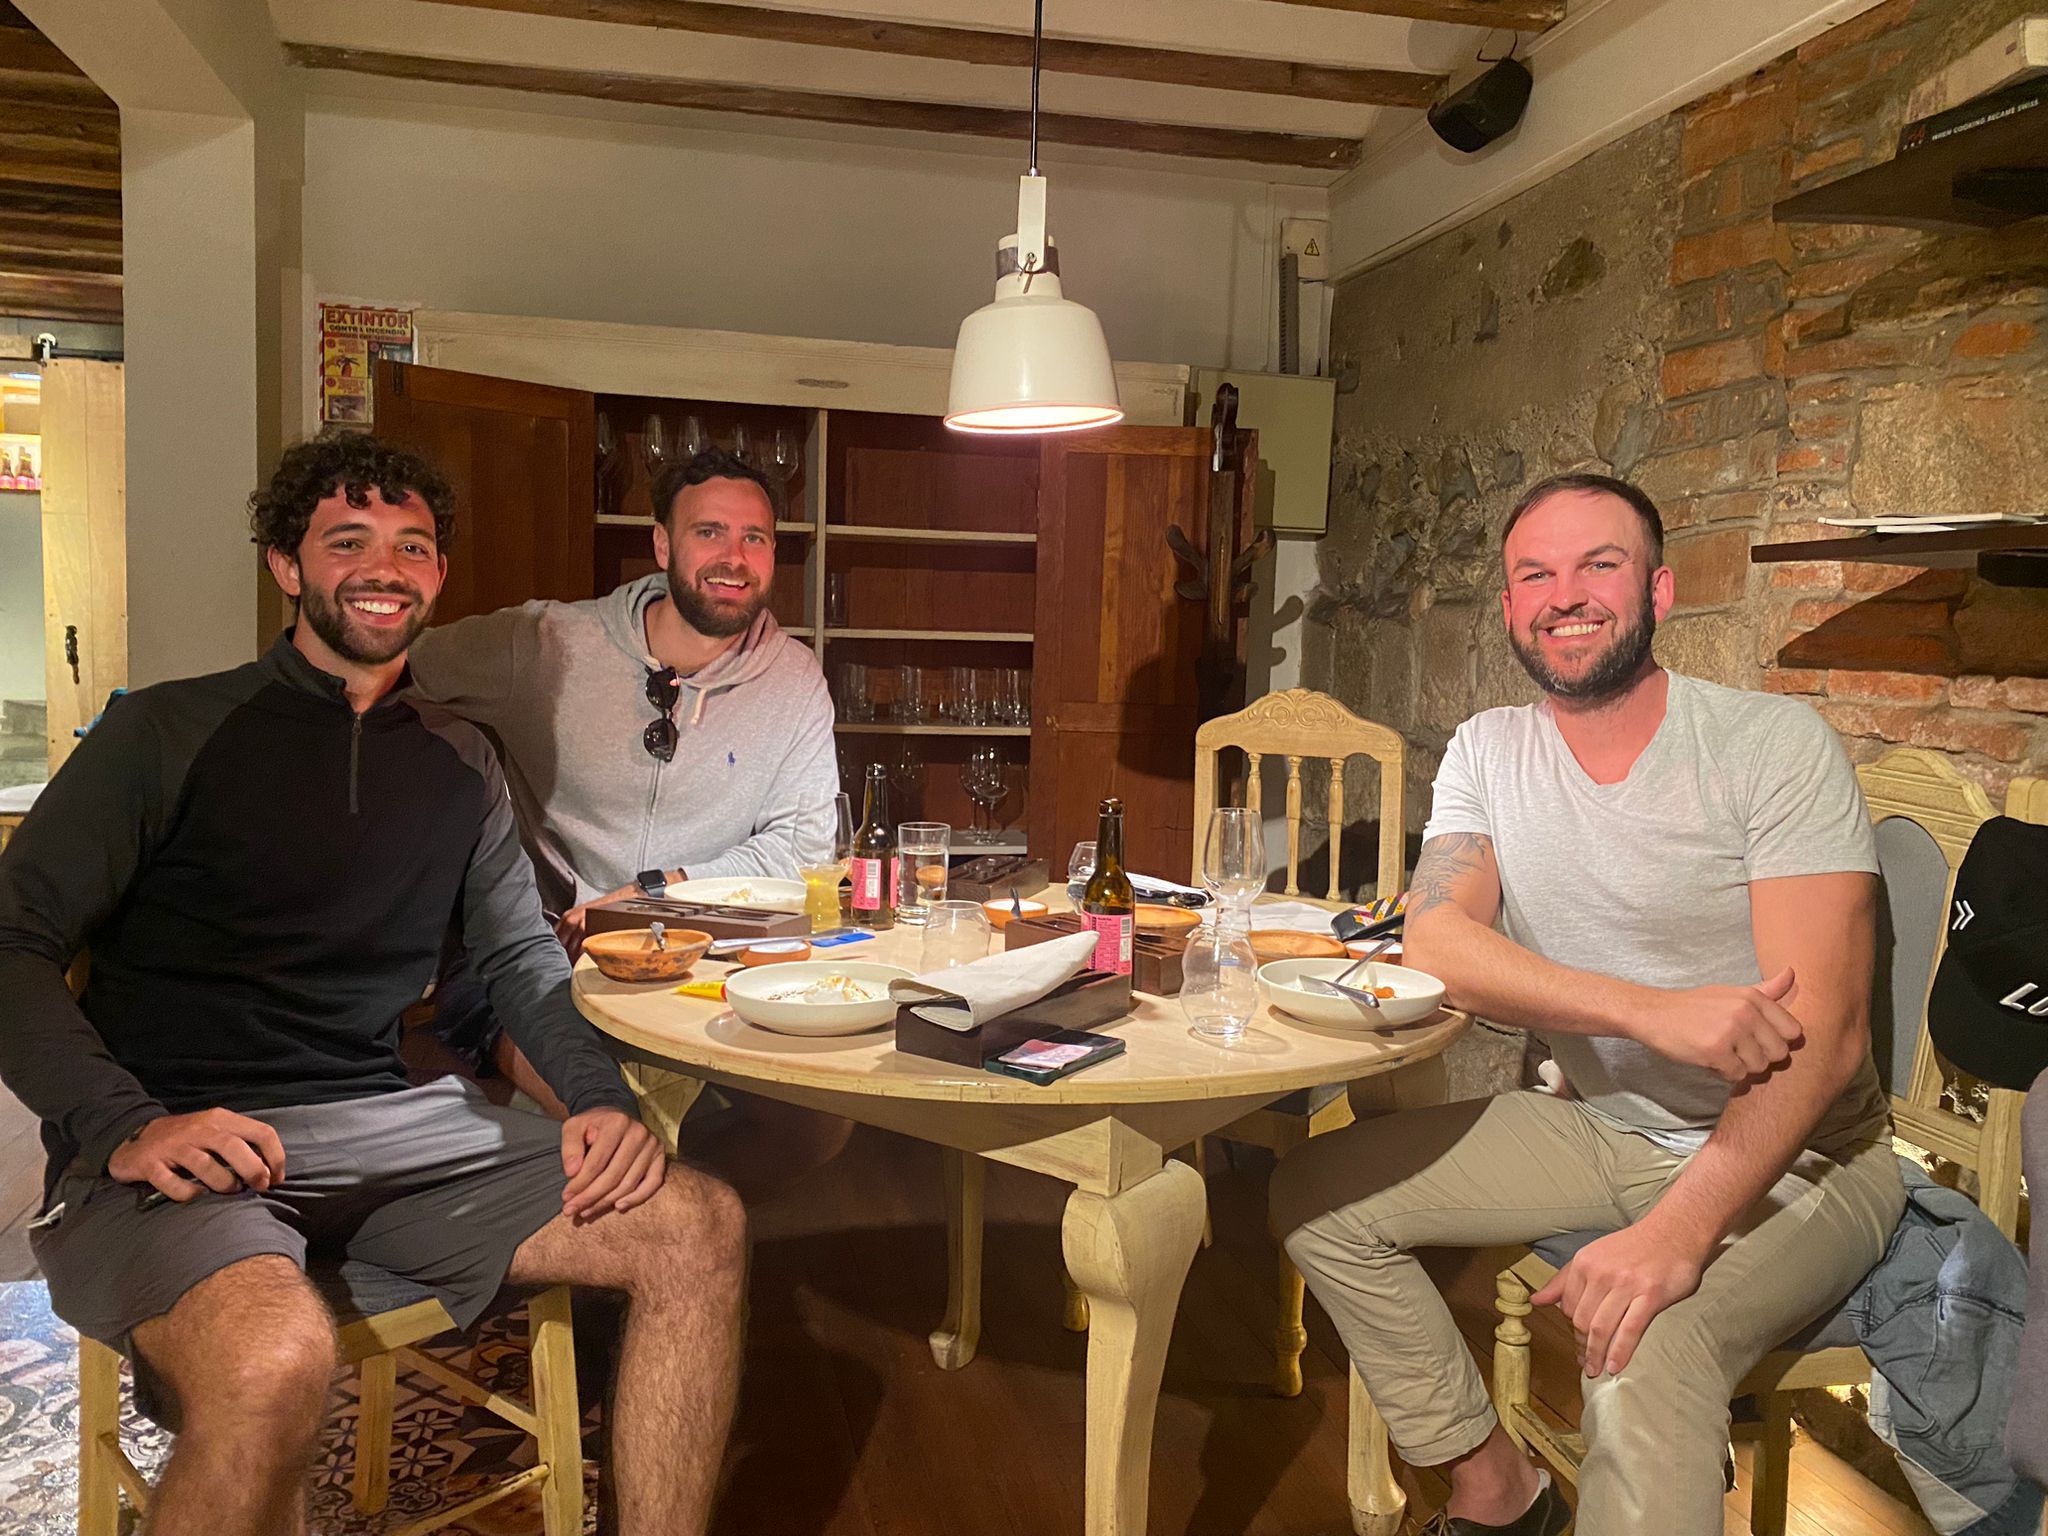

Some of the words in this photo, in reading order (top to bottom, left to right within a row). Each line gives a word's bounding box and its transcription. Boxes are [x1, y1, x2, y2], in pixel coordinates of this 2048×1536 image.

[1932, 129, 1952, 140] WHEN
[1953, 117, 1986, 133] COOKING
[1987, 106, 2015, 122] BECAME
[326, 309, 409, 329] EXTINTOR
[366, 327, 406, 336] INCENDIO
